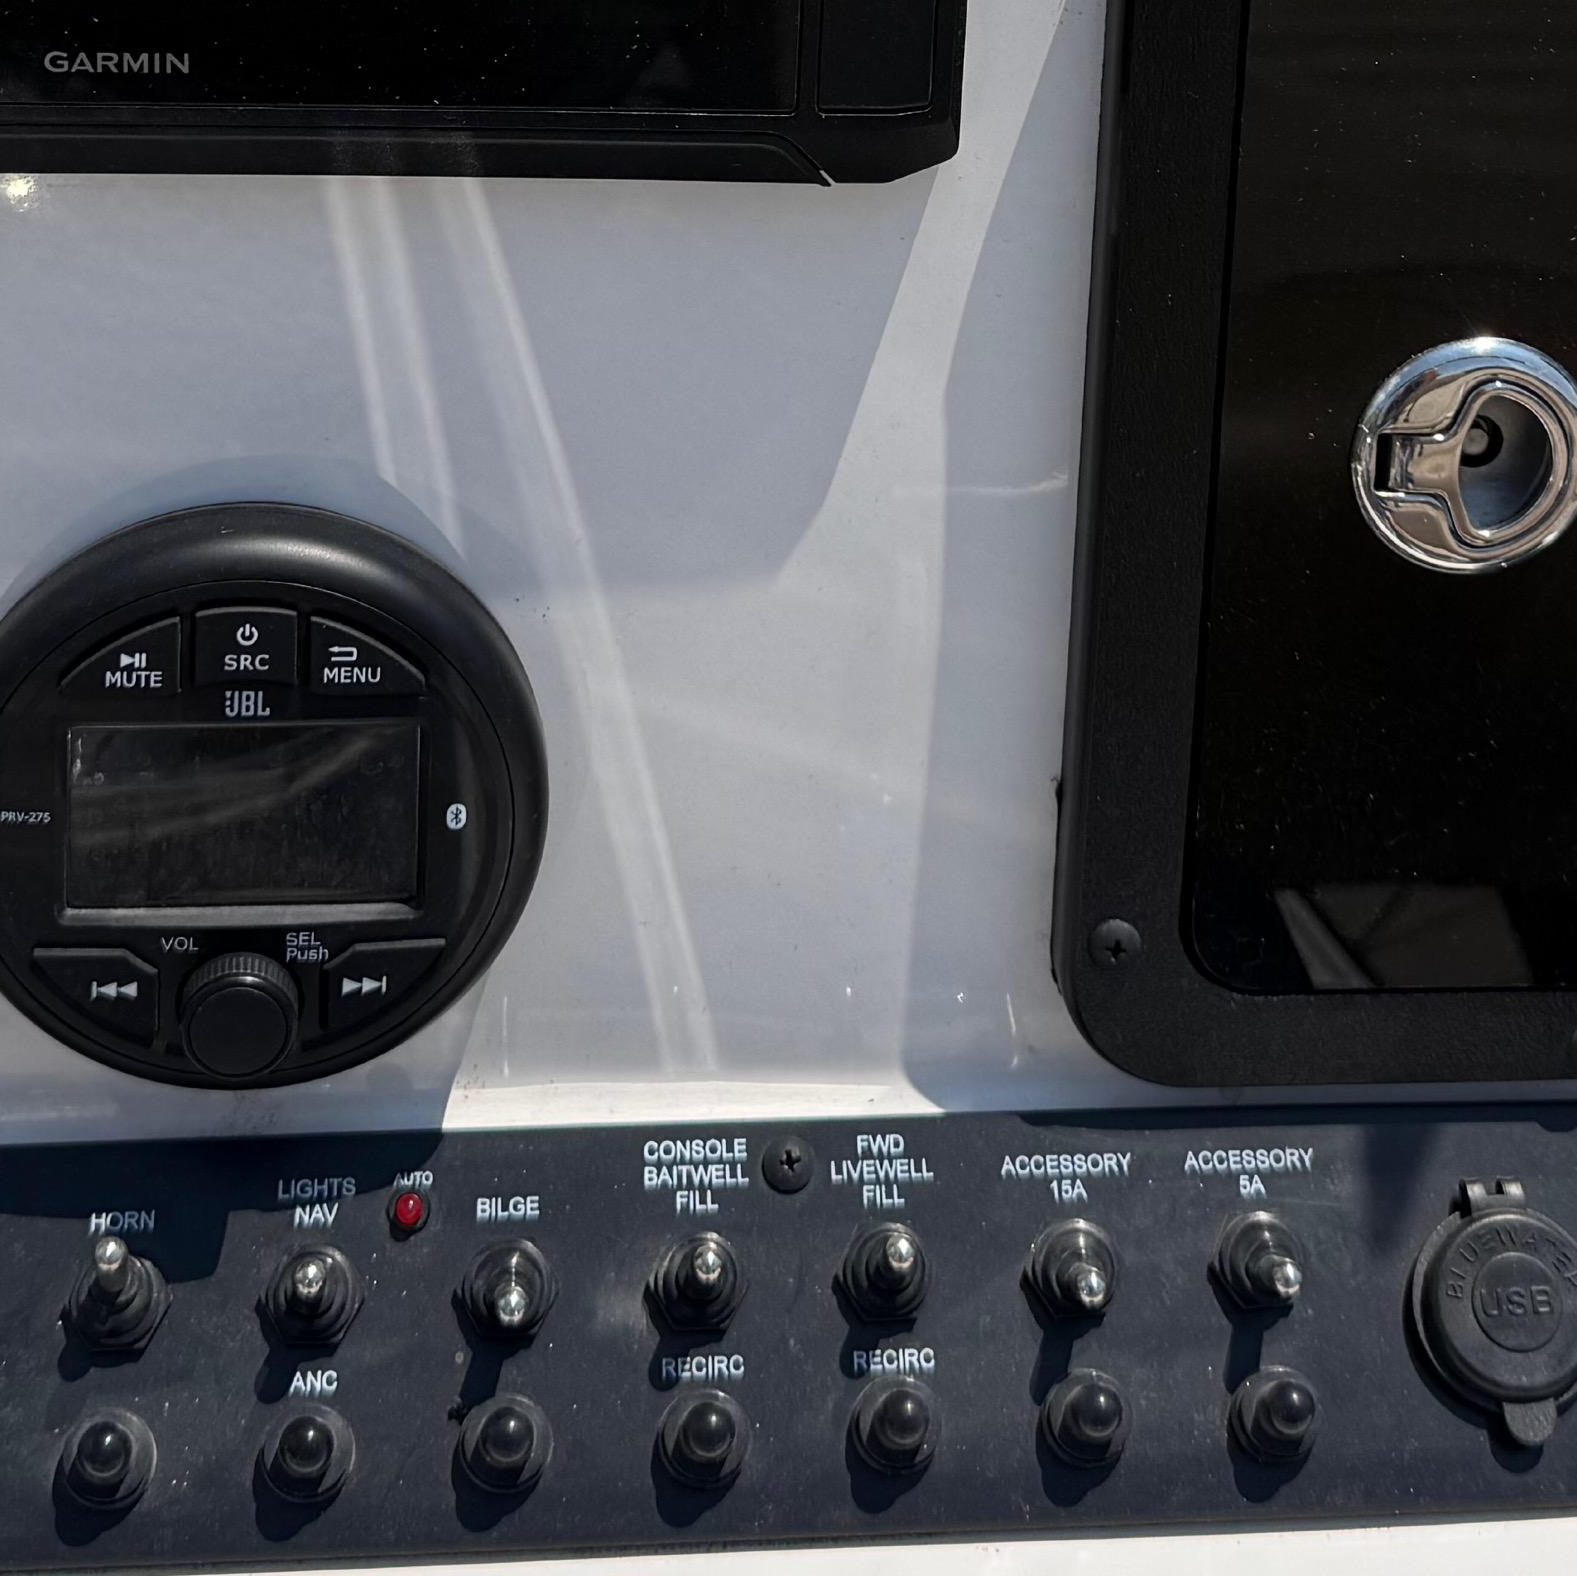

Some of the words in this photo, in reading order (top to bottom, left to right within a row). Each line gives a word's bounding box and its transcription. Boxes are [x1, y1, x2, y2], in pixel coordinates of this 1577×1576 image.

[44, 51, 190, 74] GARMIN
[224, 654, 270, 671] SRC
[105, 671, 163, 688] MUTE
[323, 667, 381, 683] MENU
[225, 691, 270, 717] JBL
[0, 811, 52, 823] PRV-275
[161, 937, 199, 952] VOL
[286, 931, 321, 945] SEL
[286, 946, 329, 962] Push
[644, 1138, 747, 1160] CONSOLE
[856, 1134, 904, 1157] FWD
[831, 1158, 934, 1184] LIVEWELL
[1001, 1152, 1131, 1177] ACCESSORY
[1184, 1147, 1313, 1172] ACCESSORY
[278, 1177, 356, 1199] LIGHTS
[393, 1171, 433, 1188] AUTO
[644, 1164, 749, 1189] BAITWELL
[1239, 1175, 1266, 1200] 5A
[675, 1190, 719, 1214] FILL
[863, 1184, 905, 1209] FILL
[1050, 1179, 1088, 1204] 15A
[294, 1203, 338, 1226] NAV
[477, 1196, 540, 1218] BILGE
[88, 1211, 155, 1234] HORN
[1480, 1285, 1553, 1317] USB
[662, 1354, 744, 1379] RECIRC
[853, 1348, 935, 1373] RECIRC
[289, 1371, 338, 1395] ANC
